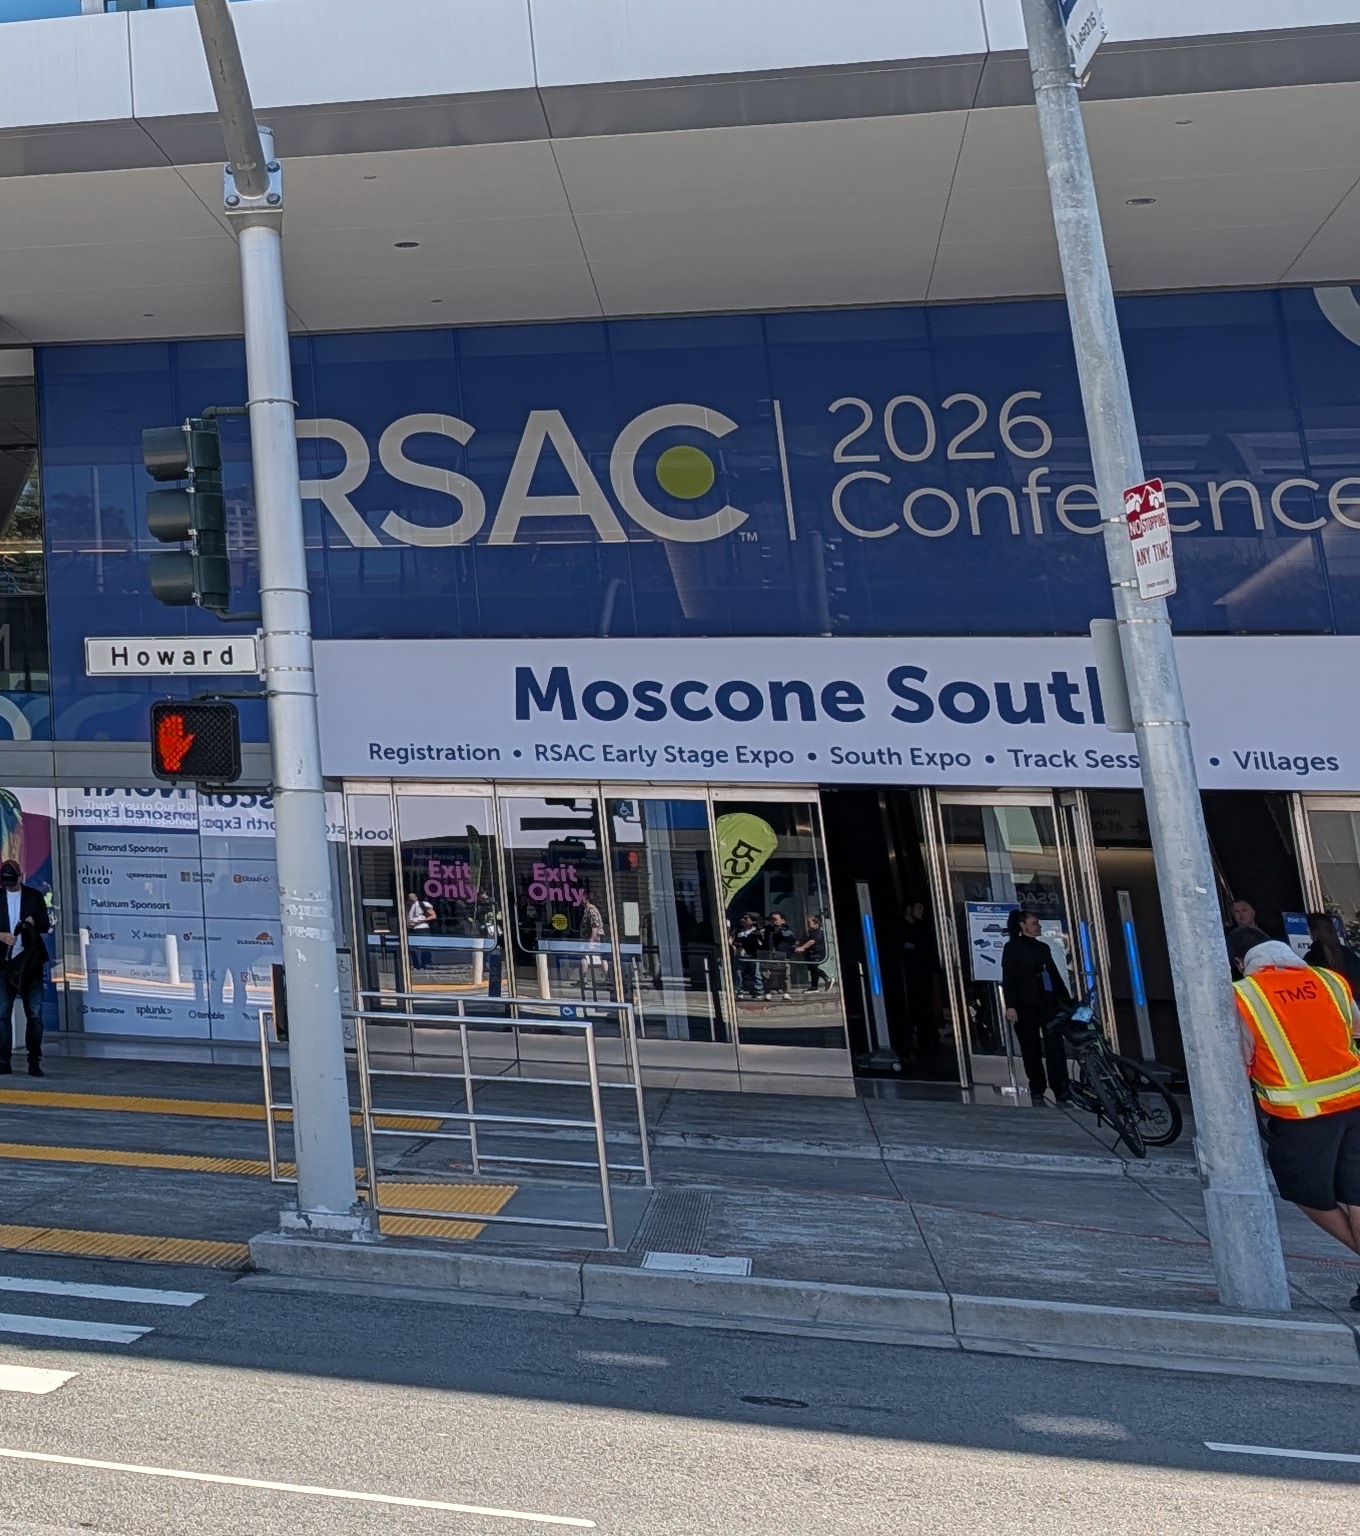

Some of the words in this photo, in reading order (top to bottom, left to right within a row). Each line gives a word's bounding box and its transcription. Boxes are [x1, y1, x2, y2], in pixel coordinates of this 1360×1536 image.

[828, 391, 1054, 464] 2026
[295, 404, 749, 546] RSAC
[832, 467, 1360, 539] Confeence
[1128, 520, 1141, 536] NO
[1141, 512, 1167, 533] STOPPING
[1136, 545, 1151, 567] ANY
[1152, 541, 1170, 562] TIME
[111, 645, 234, 666] Howard
[515, 667, 866, 722] Moscone
[369, 743, 501, 764] Registration
[535, 744, 596, 762] RSAC
[603, 744, 658, 766] Early
[664, 745, 729, 768] Stage
[736, 746, 795, 768] Expo
[830, 747, 905, 766] South
[910, 748, 972, 772] Expo
[1007, 749, 1079, 768] Track
[1085, 750, 1141, 769] Sess
[1233, 750, 1340, 775] Villages
[84, 800, 116, 808] Thank
[119, 801, 140, 810] You
[141, 802, 152, 810] to
[155, 802, 175, 811] Our
[87, 843, 127, 852] Diamond
[129, 844, 169, 853] Sponsors
[82, 876, 110, 885] CISCO
[428, 860, 472, 880] Exit
[533, 863, 578, 882] Exit
[424, 879, 478, 902] Only
[528, 882, 584, 906] Only
[91, 899, 129, 908] Platinum
[130, 900, 170, 910] Sponsors
[1273, 985, 1317, 1004] TMS
